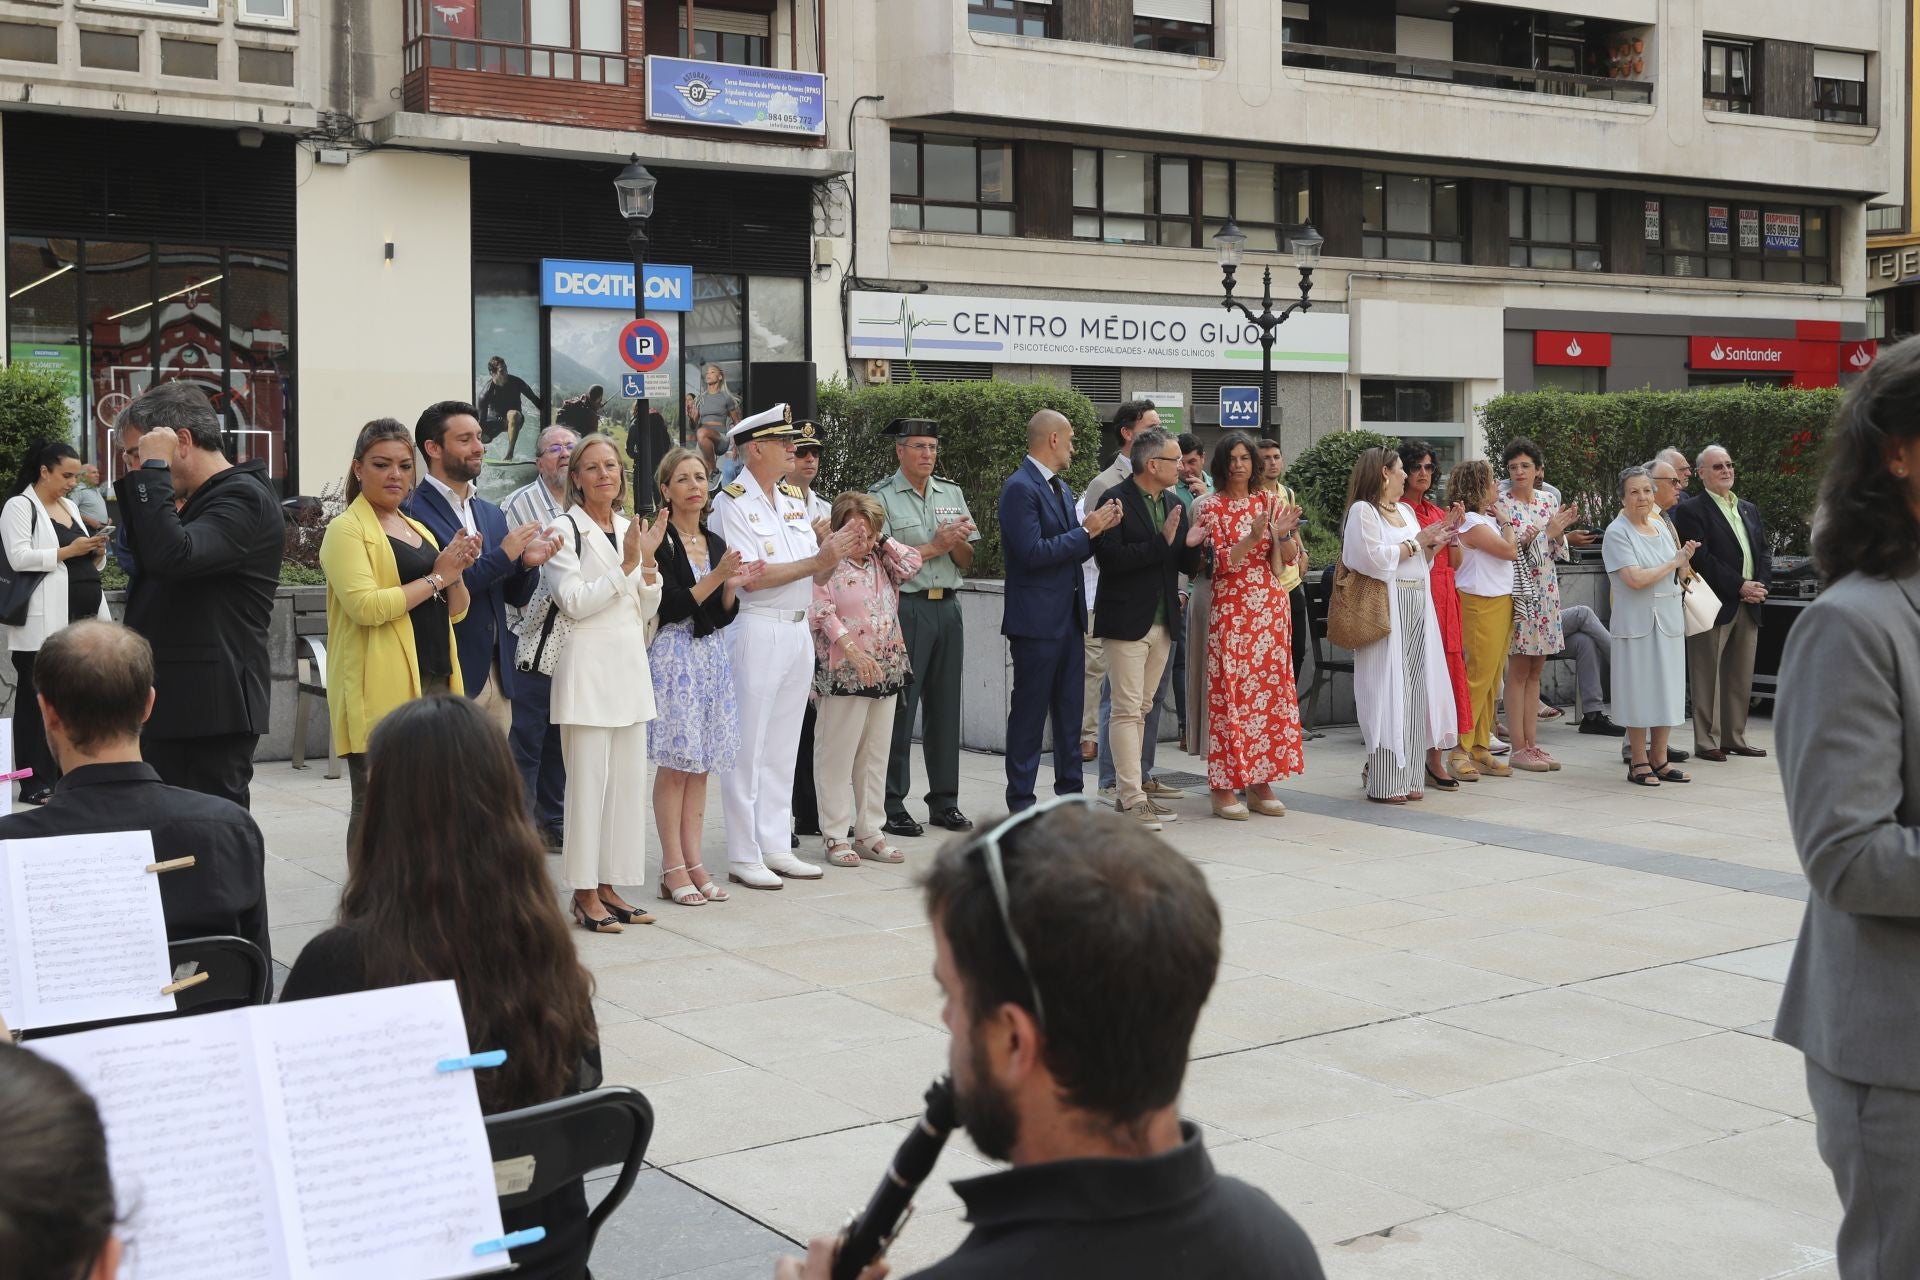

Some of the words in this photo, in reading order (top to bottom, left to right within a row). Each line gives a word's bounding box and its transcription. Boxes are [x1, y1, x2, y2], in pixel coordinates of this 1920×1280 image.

[691, 87, 704, 99] 87
[724, 78, 738, 86] Curso
[738, 79, 761, 89] Avanzado
[768, 82, 781, 91] Piloto
[787, 85, 804, 93] Drones
[804, 86, 821, 95] (RPAS)
[724, 98, 739, 106] Piloto
[739, 99, 756, 107] Privado
[799, 95, 812, 104] (TCP)
[768, 113, 782, 122] 984
[784, 114, 797, 123] 055
[799, 116, 813, 124] 772
[1709, 218, 1728, 229] ALVAREZ
[1766, 214, 1799, 225] DISPONIBLE
[1766, 223, 1777, 235] 985
[1777, 225, 1788, 236] 099
[1788, 225, 1799, 237] 099
[1765, 236, 1799, 248] ALVAREZ
[554, 271, 681, 299] DECATHON
[953, 311, 1067, 337] CENTRO
[1081, 314, 1187, 342] MÉDICO
[639, 338, 651, 354] P
[1013, 342, 1075, 353] PSICOTÉCNICO
[1079, 345, 1142, 355] ESPECIALIDADES
[1726, 346, 1782, 362] Santander
[1222, 400, 1258, 414] TAXI
